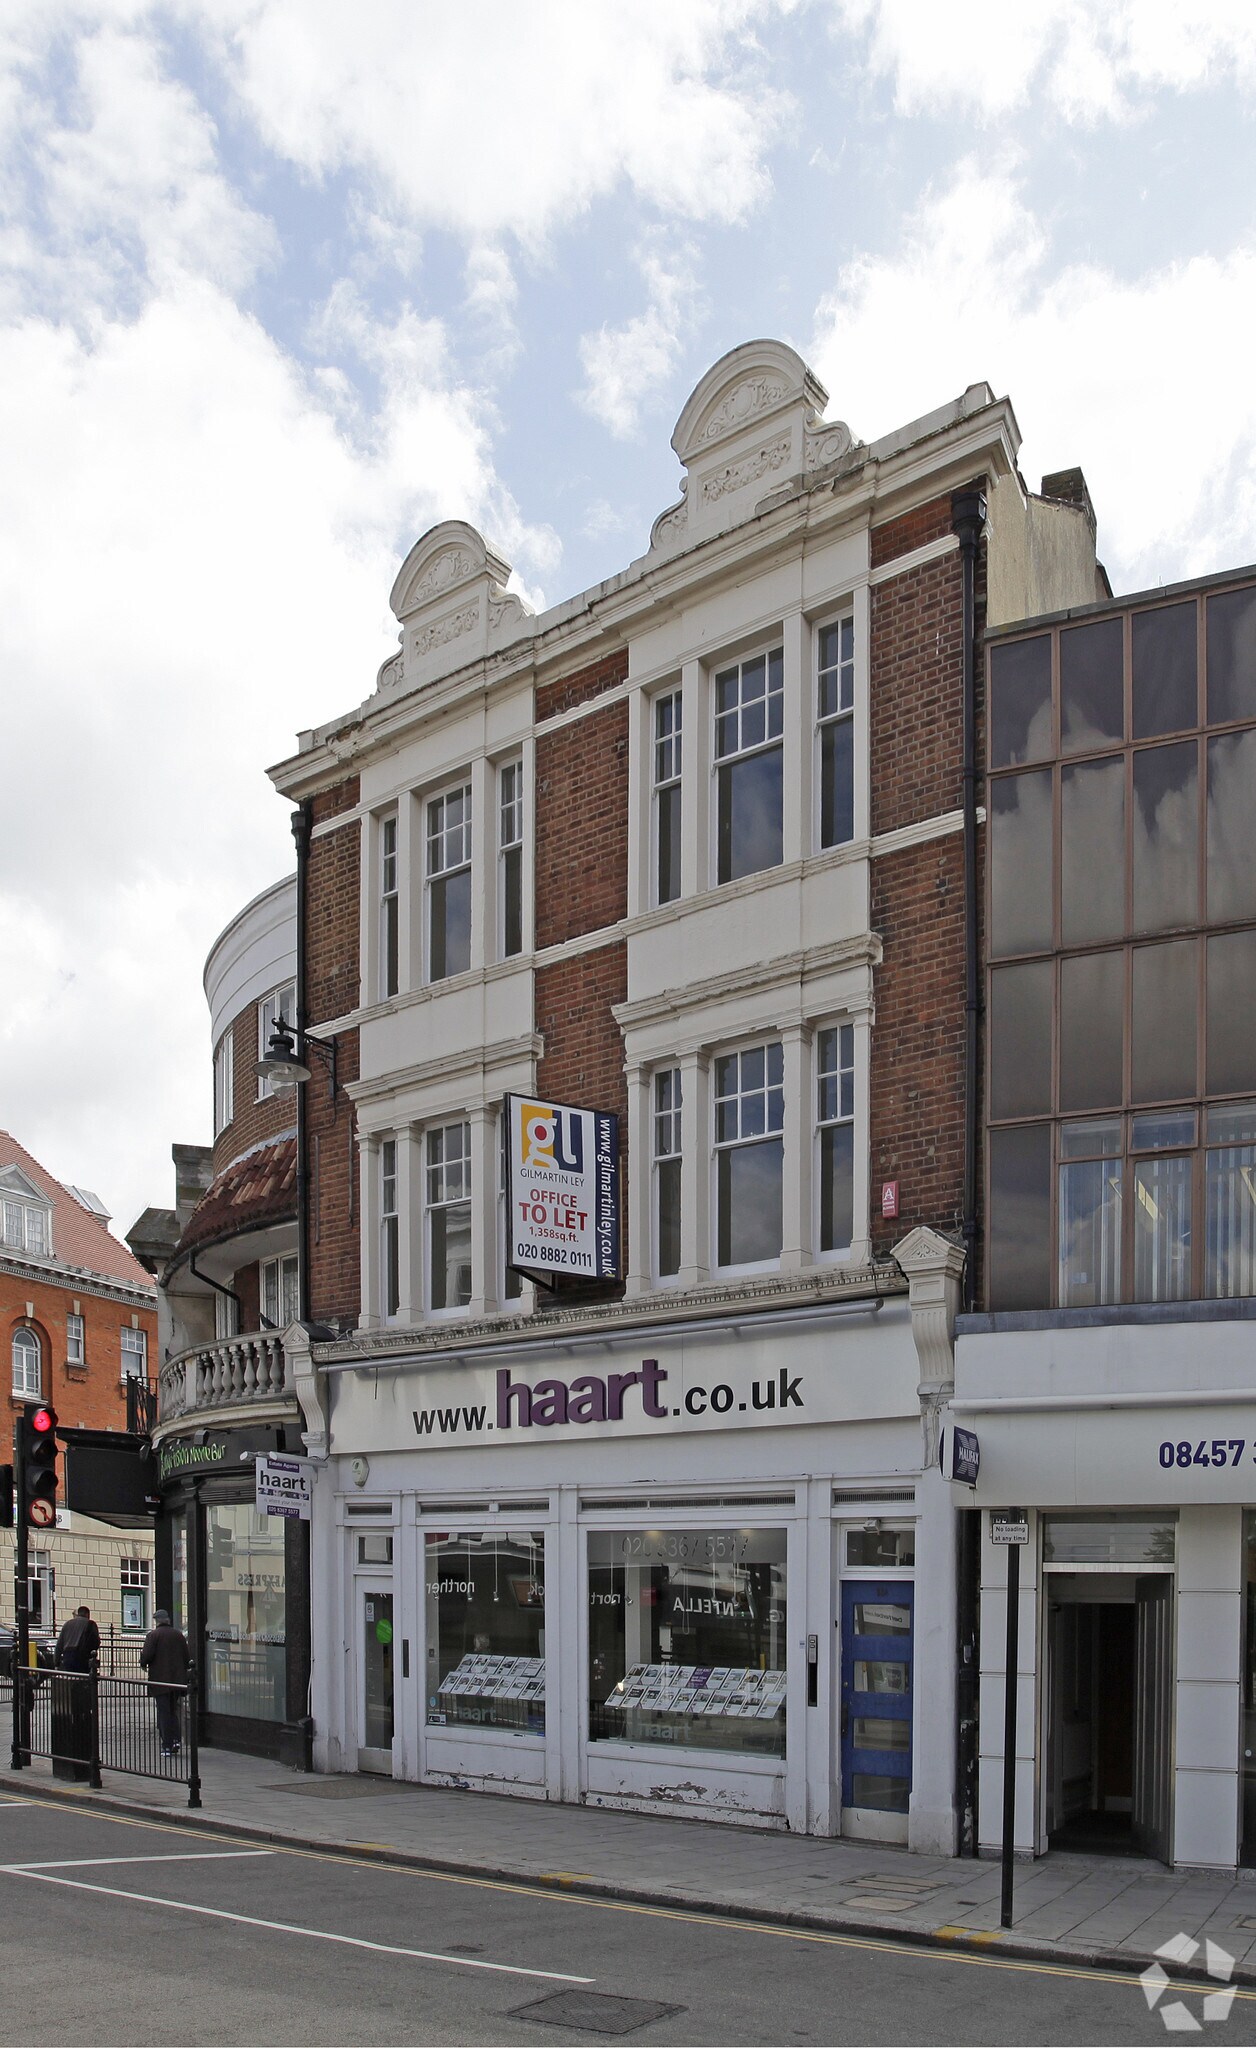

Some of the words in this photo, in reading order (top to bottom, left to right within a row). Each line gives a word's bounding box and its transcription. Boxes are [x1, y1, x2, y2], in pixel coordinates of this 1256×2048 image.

[520, 1168, 568, 1184] GILMARTIN
[570, 1177, 585, 1187] LEY
[530, 1188, 577, 1208] OFFICE
[597, 1119, 616, 1275] www.gilmartinley.co.uk
[518, 1201, 547, 1225] TO
[553, 1207, 588, 1231] LET
[517, 1243, 538, 1259] 020
[540, 1246, 567, 1263] 8882
[570, 1251, 592, 1267] 0111
[412, 1359, 804, 1435] www.haart.co.uk
[958, 1446, 979, 1466] HALIFAX
[1159, 1439, 1246, 1469] 08457
[260, 1470, 306, 1491] haart
[1004, 1525, 1026, 1533] loading
